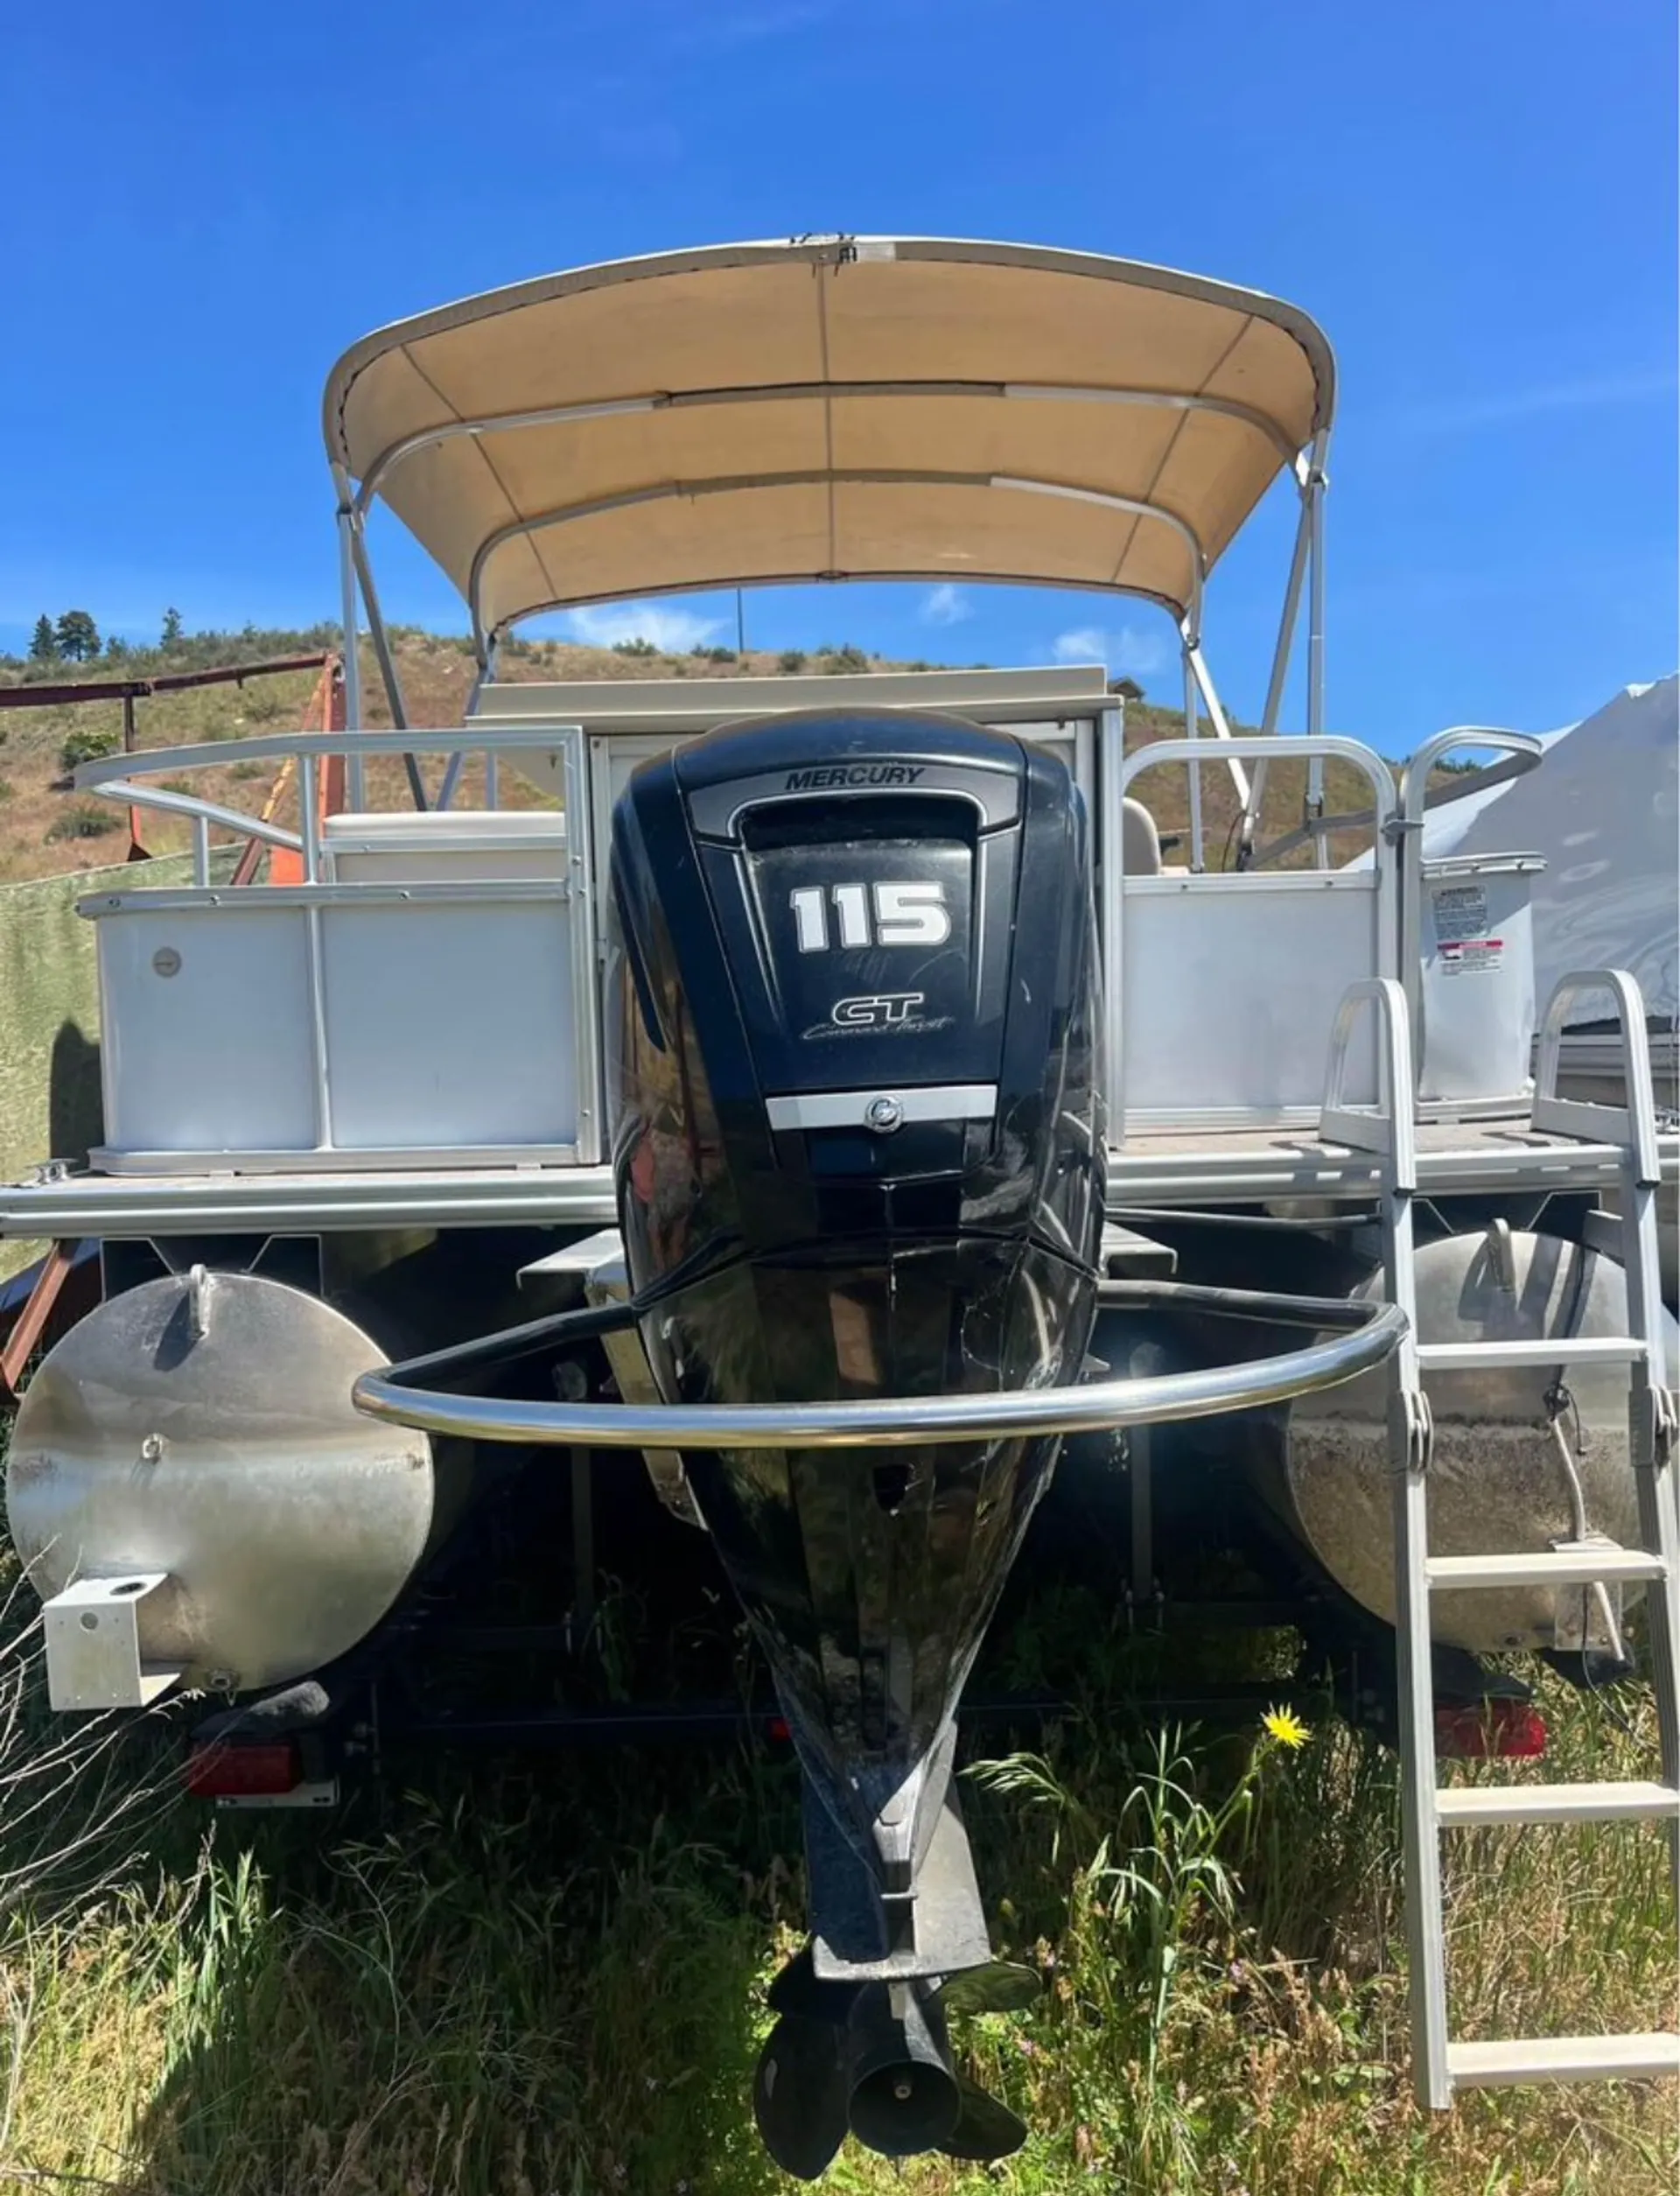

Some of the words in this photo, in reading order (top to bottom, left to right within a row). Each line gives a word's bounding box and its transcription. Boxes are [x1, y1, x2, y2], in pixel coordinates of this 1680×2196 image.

[785, 766, 926, 790] MERCURY
[789, 881, 951, 954] 115
[832, 992, 925, 1026] GT
